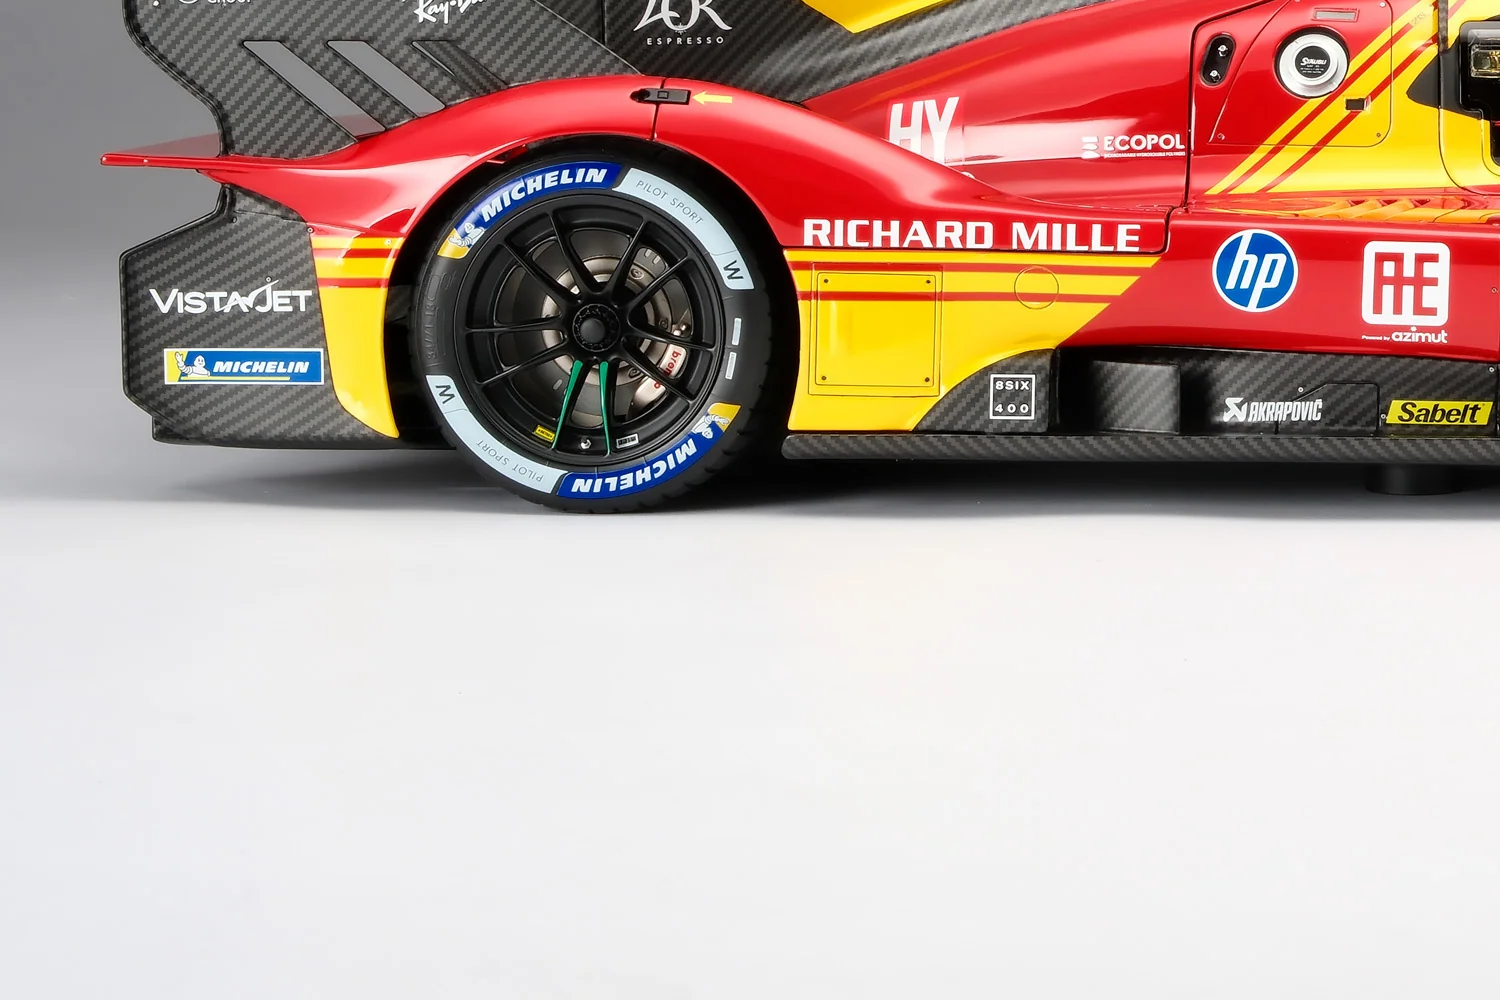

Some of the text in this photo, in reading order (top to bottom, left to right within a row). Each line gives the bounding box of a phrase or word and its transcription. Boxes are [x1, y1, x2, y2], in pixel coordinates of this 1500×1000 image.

[646, 36, 725, 45] ESPRESSO
[889, 96, 960, 164] HY
[1103, 133, 1186, 151] ECOPOL
[480, 167, 608, 222] MICHELIN
[636, 180, 704, 225] PILOT SPORT
[803, 218, 1142, 253] RICHARD MILLE
[1225, 231, 1286, 311] hp
[1391, 327, 1448, 344] azimut
[213, 360, 310, 374] MICHELIN
[994, 380, 1031, 391] 8SIX
[994, 403, 1030, 414] 400
[1397, 401, 1482, 424] Sabelt
[476, 439, 544, 483] PILOT SPORT
[571, 440, 698, 494] MICHELIN
